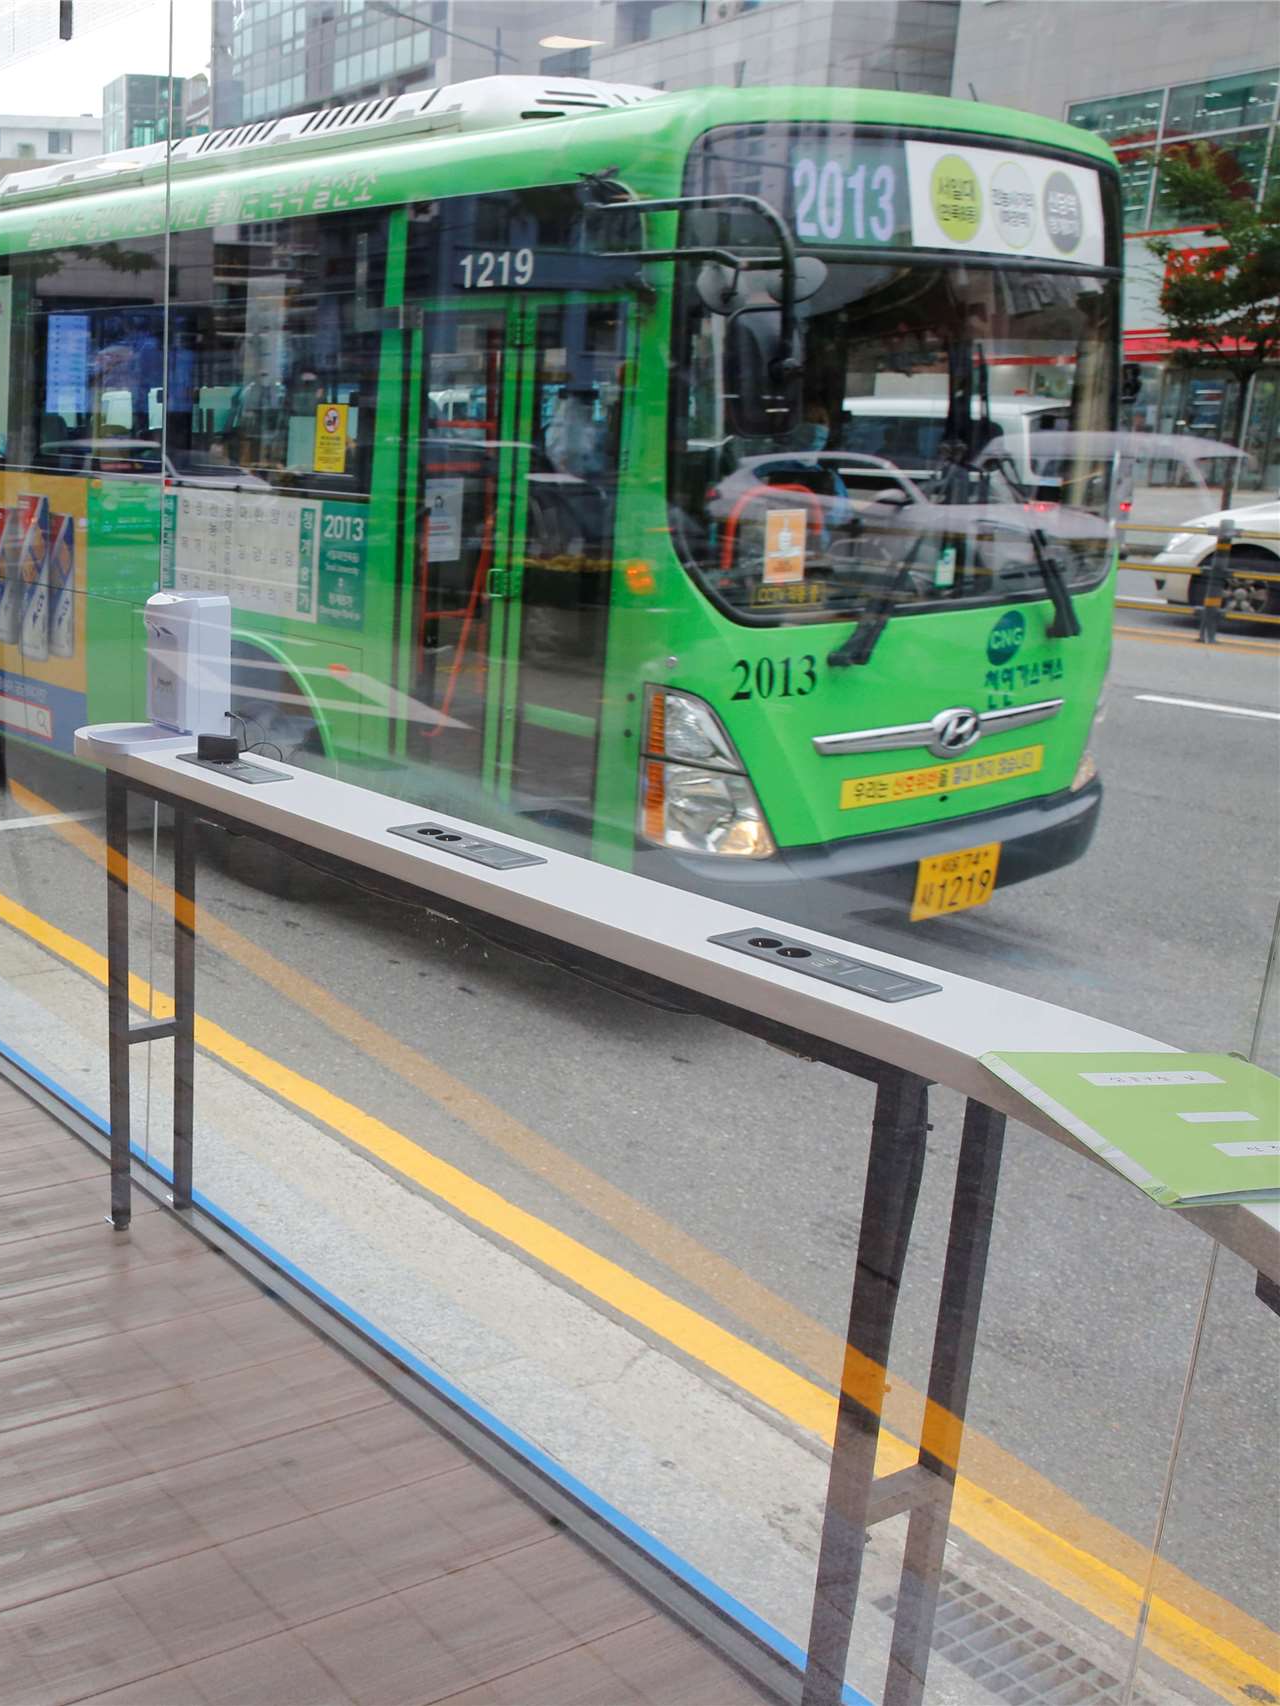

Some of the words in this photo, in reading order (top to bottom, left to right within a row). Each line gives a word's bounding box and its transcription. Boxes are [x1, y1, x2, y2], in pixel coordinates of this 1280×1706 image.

[793, 156, 896, 243] 2013
[459, 247, 535, 289] 1219
[323, 514, 365, 542] 2013
[991, 627, 1022, 650] CNG
[730, 654, 818, 701] 2013
[854, 781, 888, 801] 우리는
